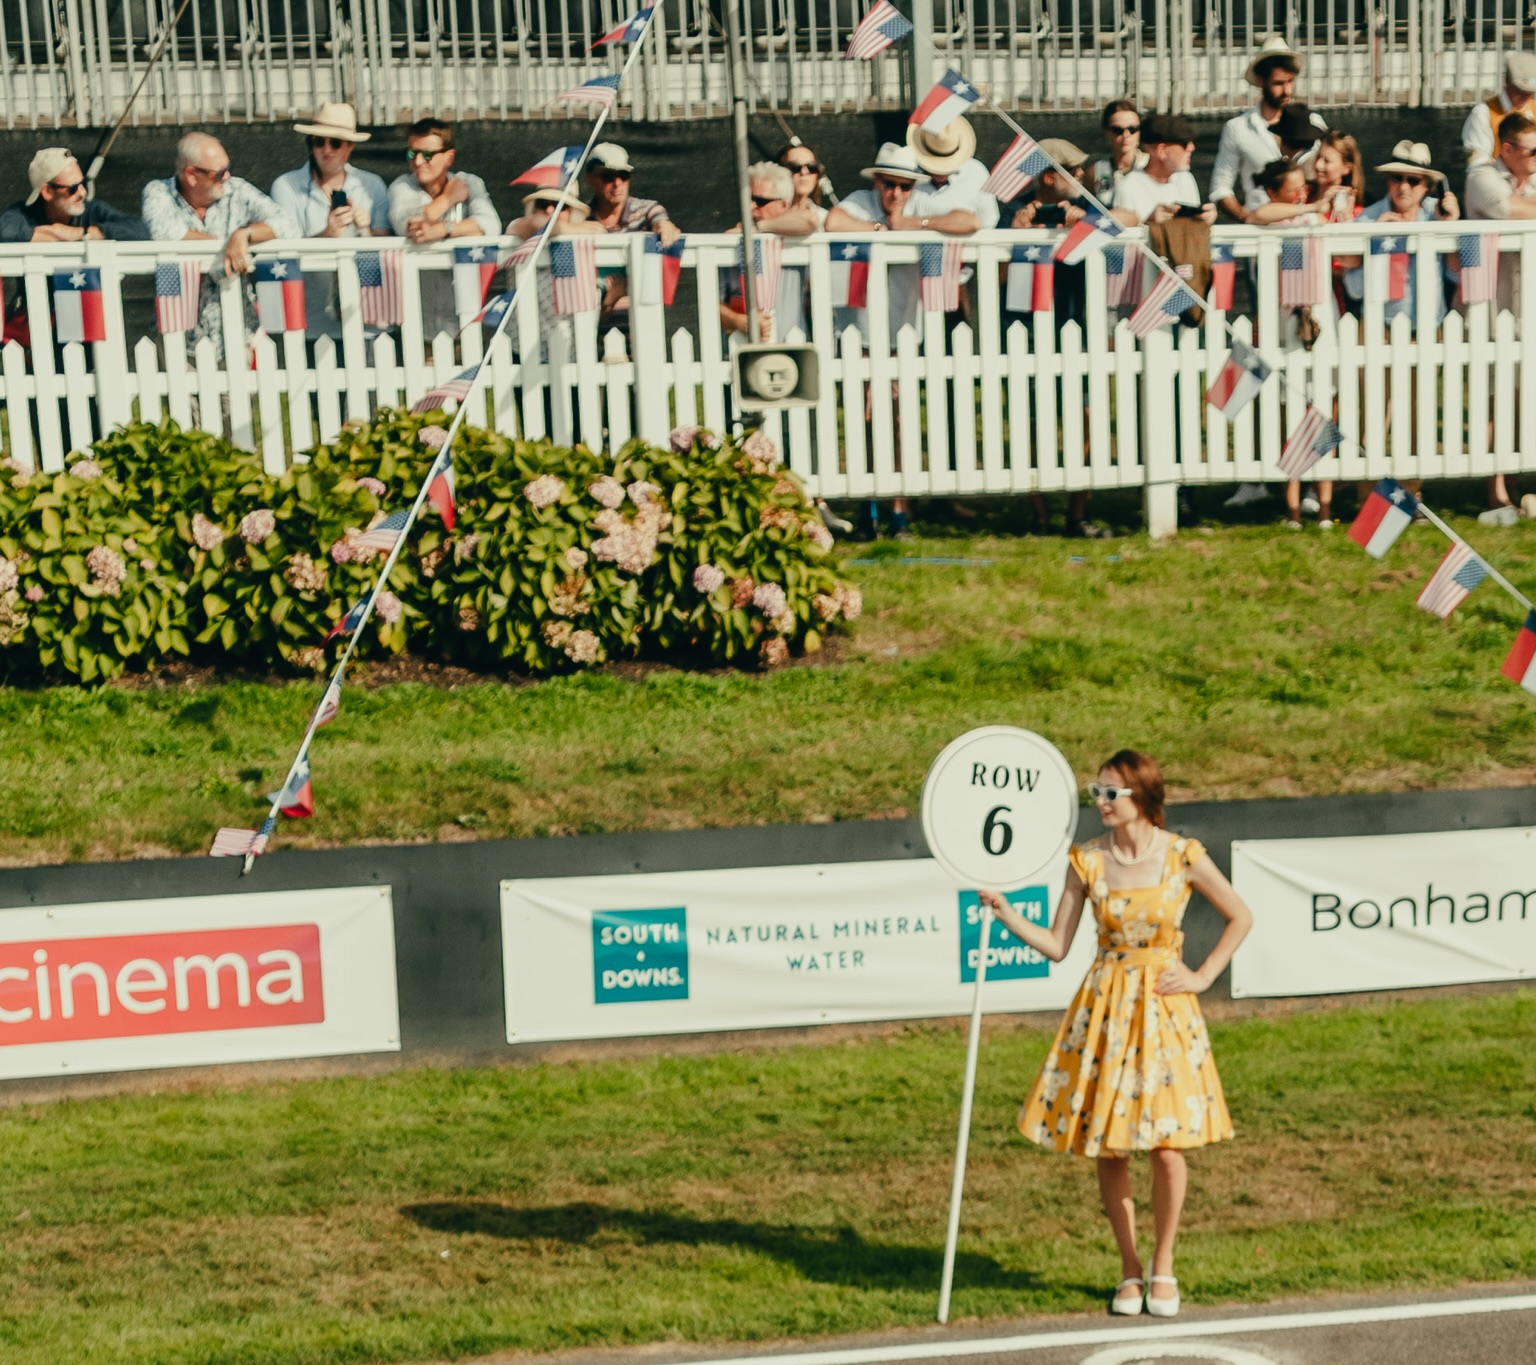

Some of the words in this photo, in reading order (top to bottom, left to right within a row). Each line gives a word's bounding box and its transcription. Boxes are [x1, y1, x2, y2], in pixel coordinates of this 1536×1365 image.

[970, 762, 1040, 792] ROW
[982, 805, 1013, 855] 6
[966, 901, 1042, 925] STH
[600, 922, 680, 945] SOUTH
[706, 922, 820, 944] NATURAL
[832, 915, 941, 939] MINERAL
[786, 950, 866, 971] WATER
[0, 948, 304, 1024] cinema
